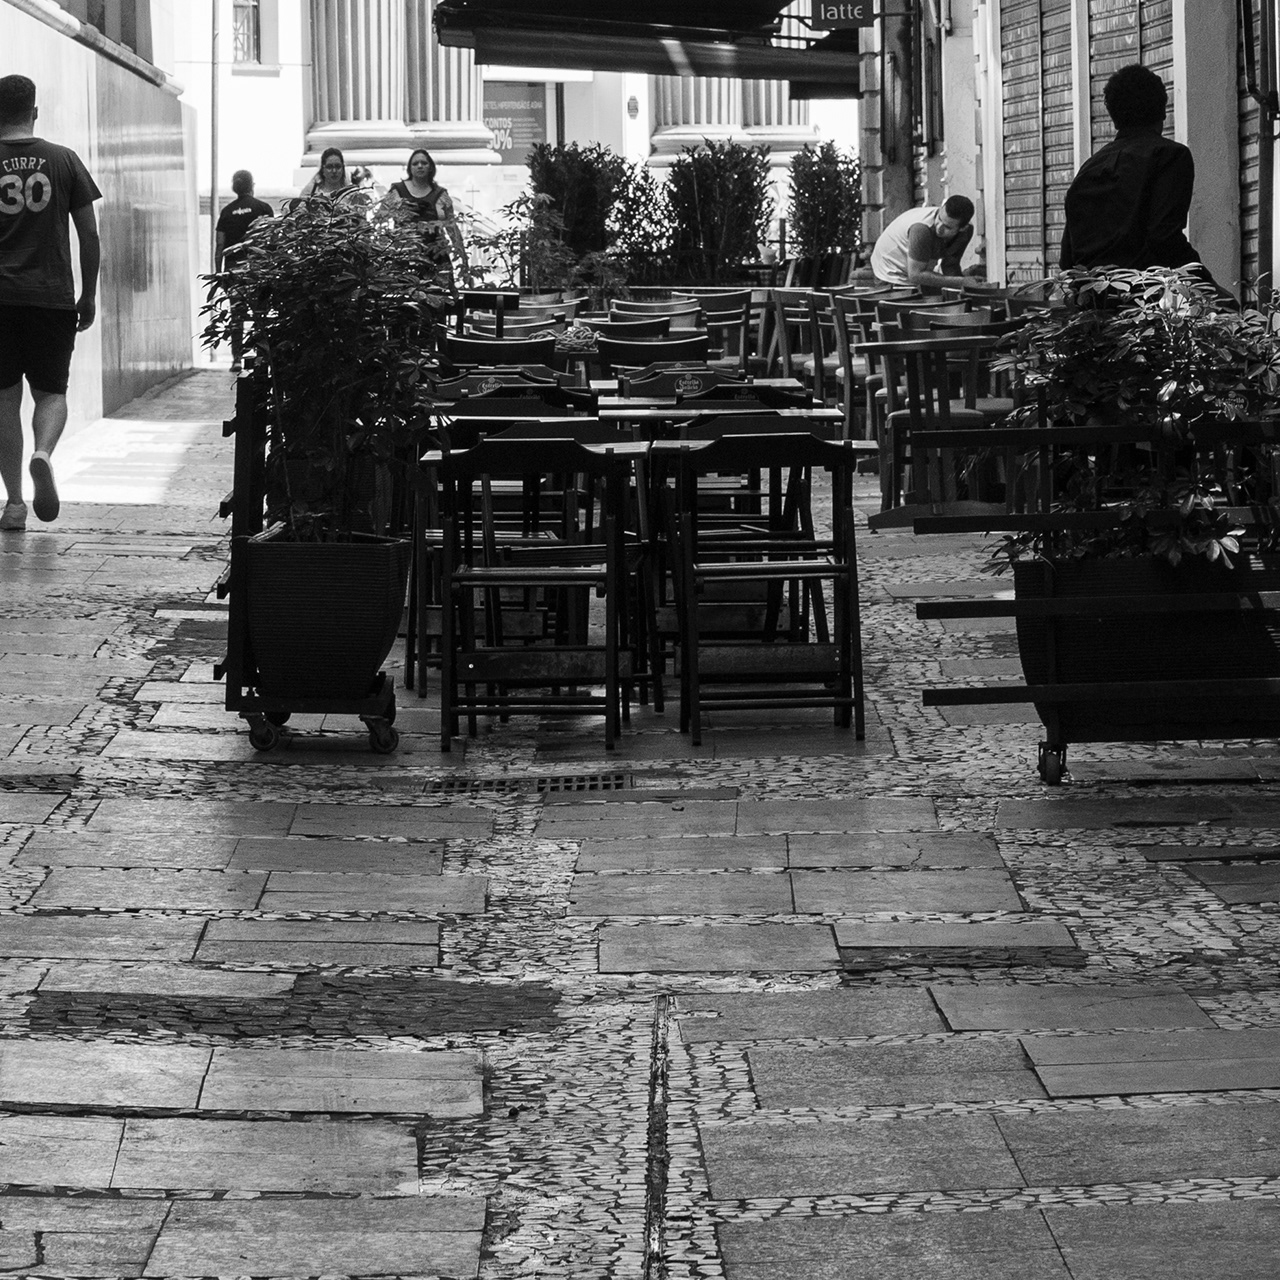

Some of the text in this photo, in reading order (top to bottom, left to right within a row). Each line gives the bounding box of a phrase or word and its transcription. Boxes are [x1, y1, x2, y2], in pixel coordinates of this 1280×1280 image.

[820, 3, 864, 20] latte
[484, 118, 512, 128] CONTOS
[2, 156, 47, 173] CURRY
